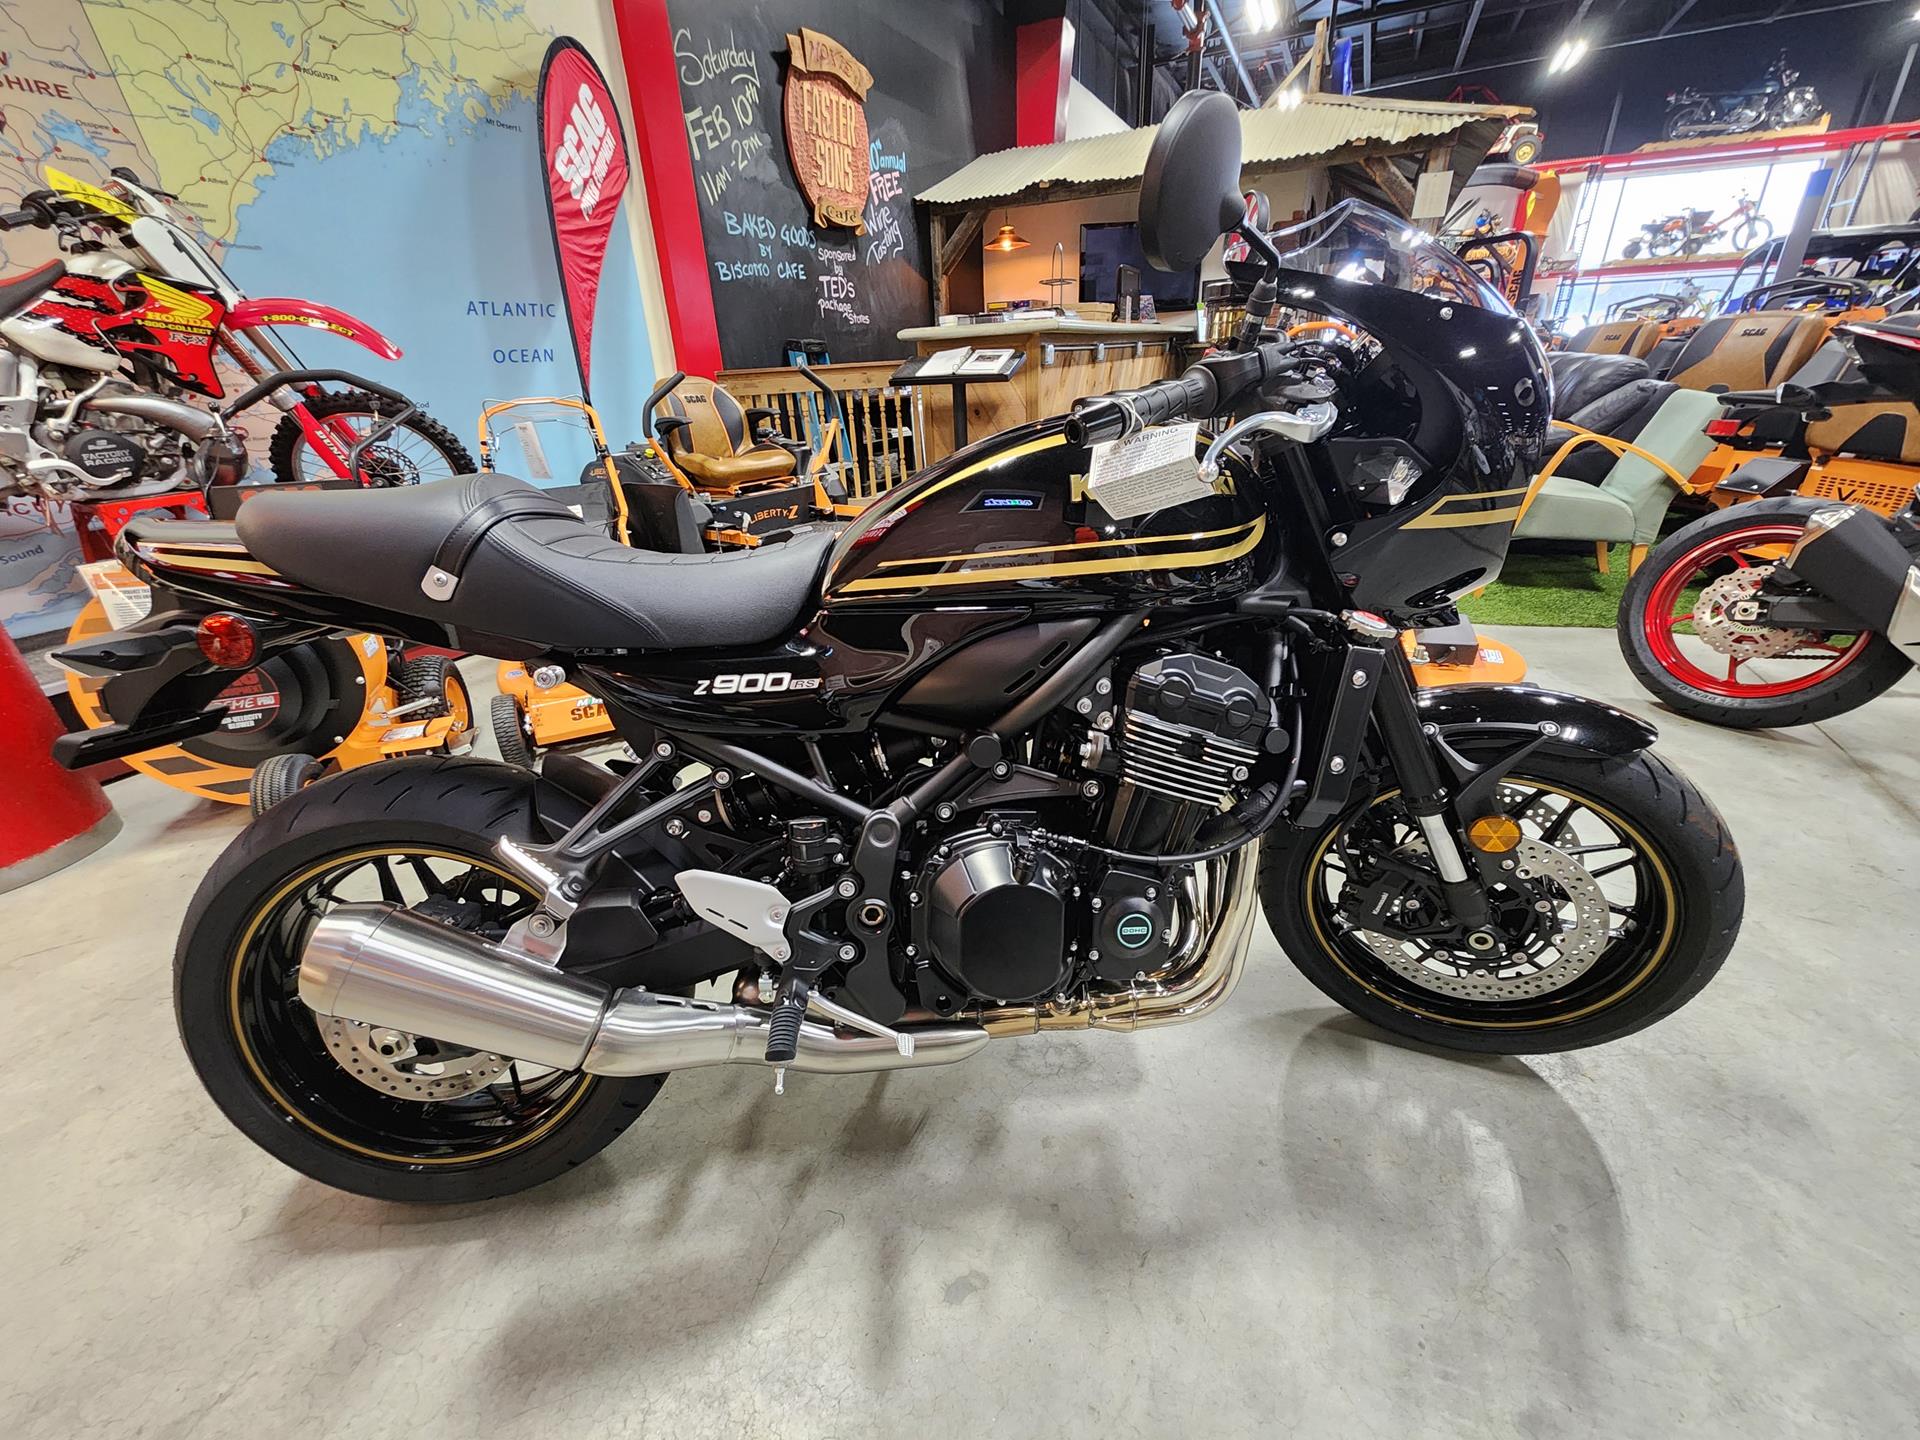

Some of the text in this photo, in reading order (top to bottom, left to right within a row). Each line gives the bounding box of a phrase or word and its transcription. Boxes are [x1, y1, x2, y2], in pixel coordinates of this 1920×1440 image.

[674, 28, 760, 88] Saturday
[303, 67, 340, 83] AUGUSTA
[0, 74, 73, 100] HIRE
[801, 81, 856, 148] FASTER
[496, 120, 518, 132] Desert
[684, 105, 732, 161] FEB
[554, 82, 607, 200] SCAG
[592, 126, 616, 190] EQUIPMENT
[813, 138, 853, 193] SONS
[880, 152, 906, 173] annual
[869, 171, 903, 206] FREE
[826, 205, 857, 223] Café
[864, 203, 893, 237] Wine
[723, 211, 817, 249] BAKED GOODS
[758, 243, 772, 260] BY
[866, 220, 904, 266] Tasting
[818, 247, 856, 266] sponsored
[777, 262, 807, 280] CAFE
[833, 262, 844, 276] by
[1507, 269, 1522, 303] SCAG
[466, 300, 556, 318] ATLANTIC
[818, 299, 852, 318] package
[145, 311, 215, 329] HONDA
[1740, 328, 1767, 337] SCAG
[492, 348, 554, 364] OCEAN
[684, 395, 707, 404] SCAG
[1123, 427, 1178, 446] WARNING
[81, 450, 129, 461] FACTORY
[84, 456, 134, 466] RACING
[0, 545, 44, 565] Sound
